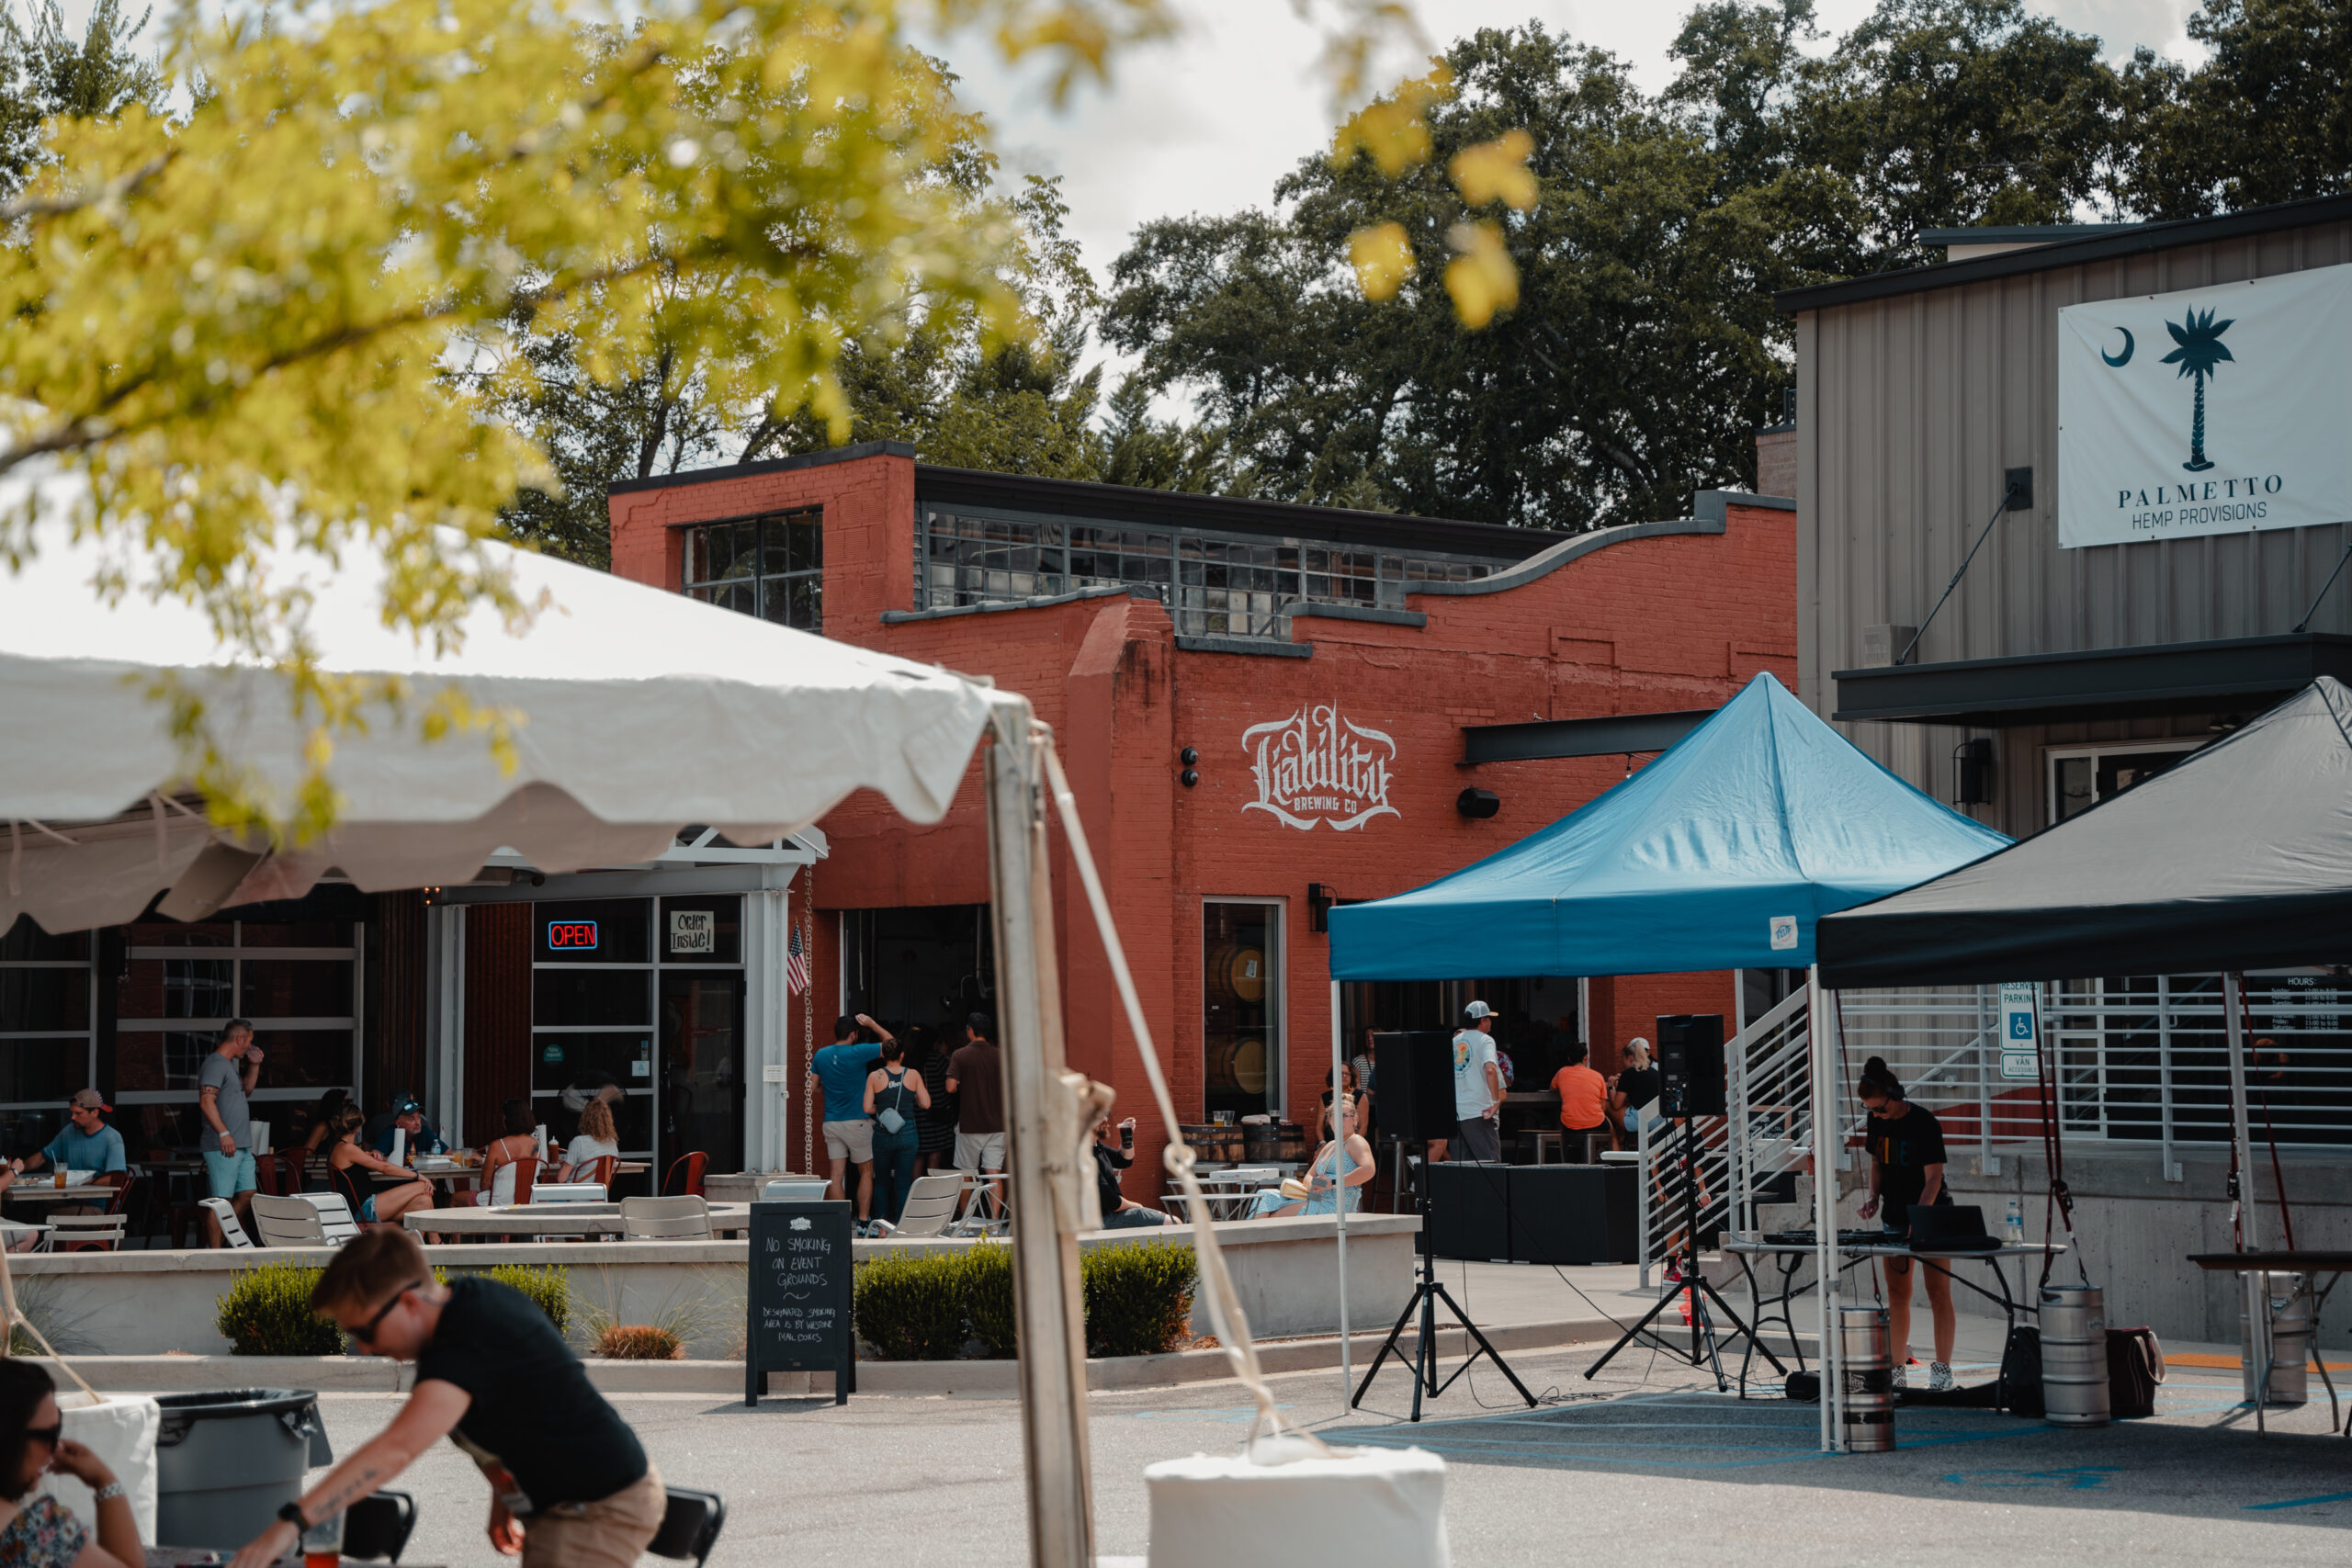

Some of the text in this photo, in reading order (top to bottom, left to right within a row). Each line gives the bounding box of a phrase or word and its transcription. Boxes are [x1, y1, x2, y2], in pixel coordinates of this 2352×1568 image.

[2118, 474, 2282, 508] PALMETTO
[2132, 501, 2267, 530] HEMP PROVISIONS
[1294, 795, 1358, 814] BREWING CO
[677, 913, 707, 931] Order
[550, 925, 595, 946] OPEN
[671, 928, 711, 953] Inside!
[2004, 994, 2034, 1003] PARKIN
[765, 1236, 831, 1255] NO SMOKING
[772, 1256, 823, 1270] ON EVENT
[777, 1272, 828, 1290] GROUNDS
[763, 1305, 836, 1318] DESIGNATED SMOKING
[785, 1320, 792, 1328] IS
[795, 1318, 805, 1329] BY
